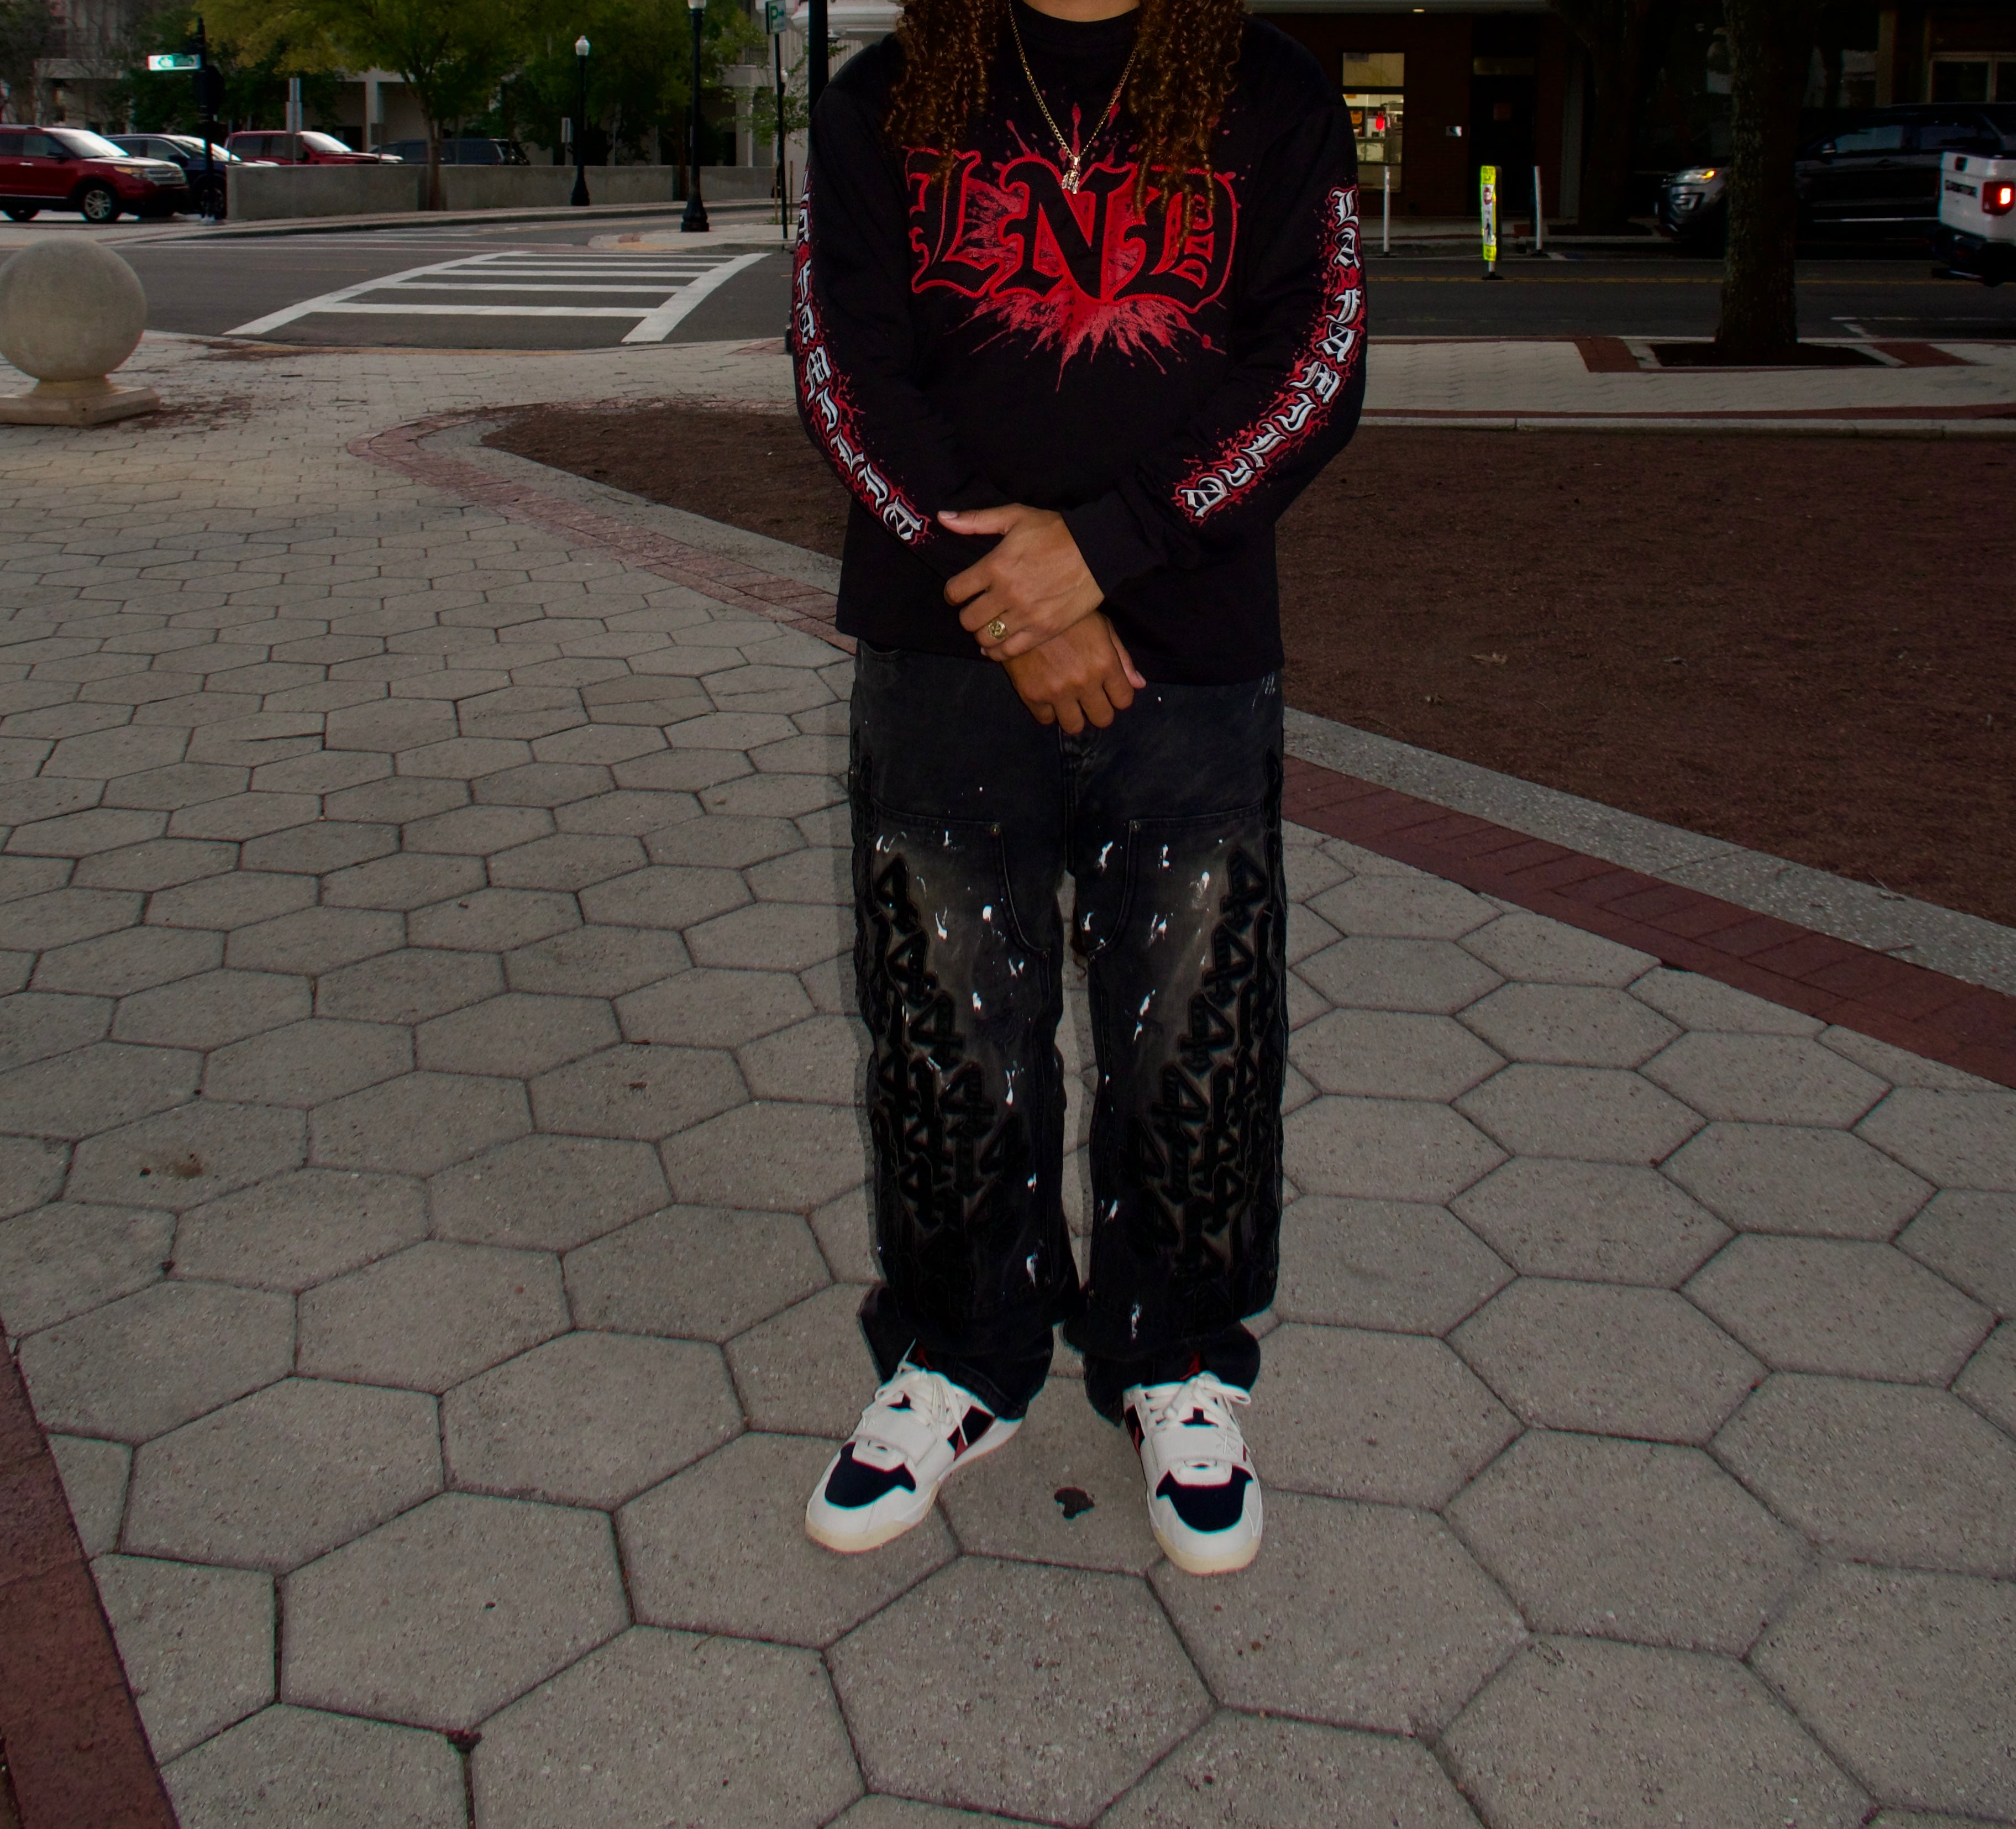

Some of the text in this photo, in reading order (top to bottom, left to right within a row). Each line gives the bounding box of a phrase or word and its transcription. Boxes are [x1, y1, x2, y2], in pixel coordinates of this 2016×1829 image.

[796, 258, 924, 541] FAMILIA
[1179, 188, 1363, 518] LA FAMILIA
